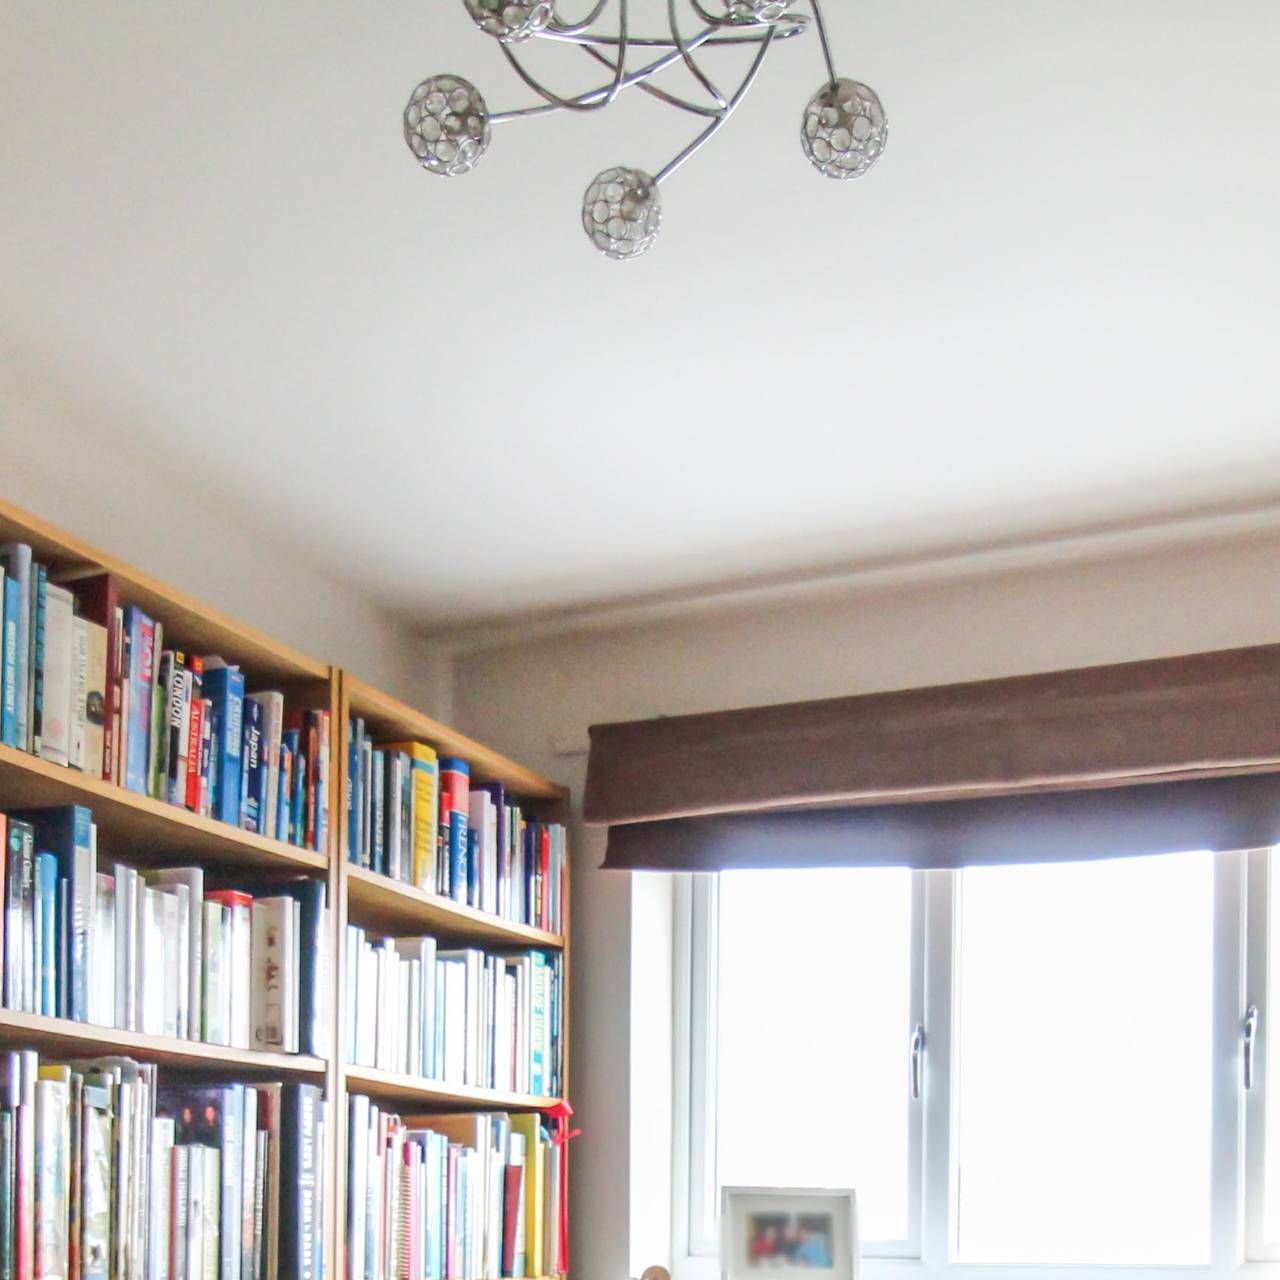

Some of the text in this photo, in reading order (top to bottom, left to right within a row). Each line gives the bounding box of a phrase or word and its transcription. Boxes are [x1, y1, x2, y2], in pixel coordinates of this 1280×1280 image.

[76, 659, 85, 694] ISLAND
[76, 698, 84, 729] STORY
[170, 670, 184, 728] LONDON
[188, 706, 199, 773] AUSTRALIA
[249, 726, 261, 768] Japan
